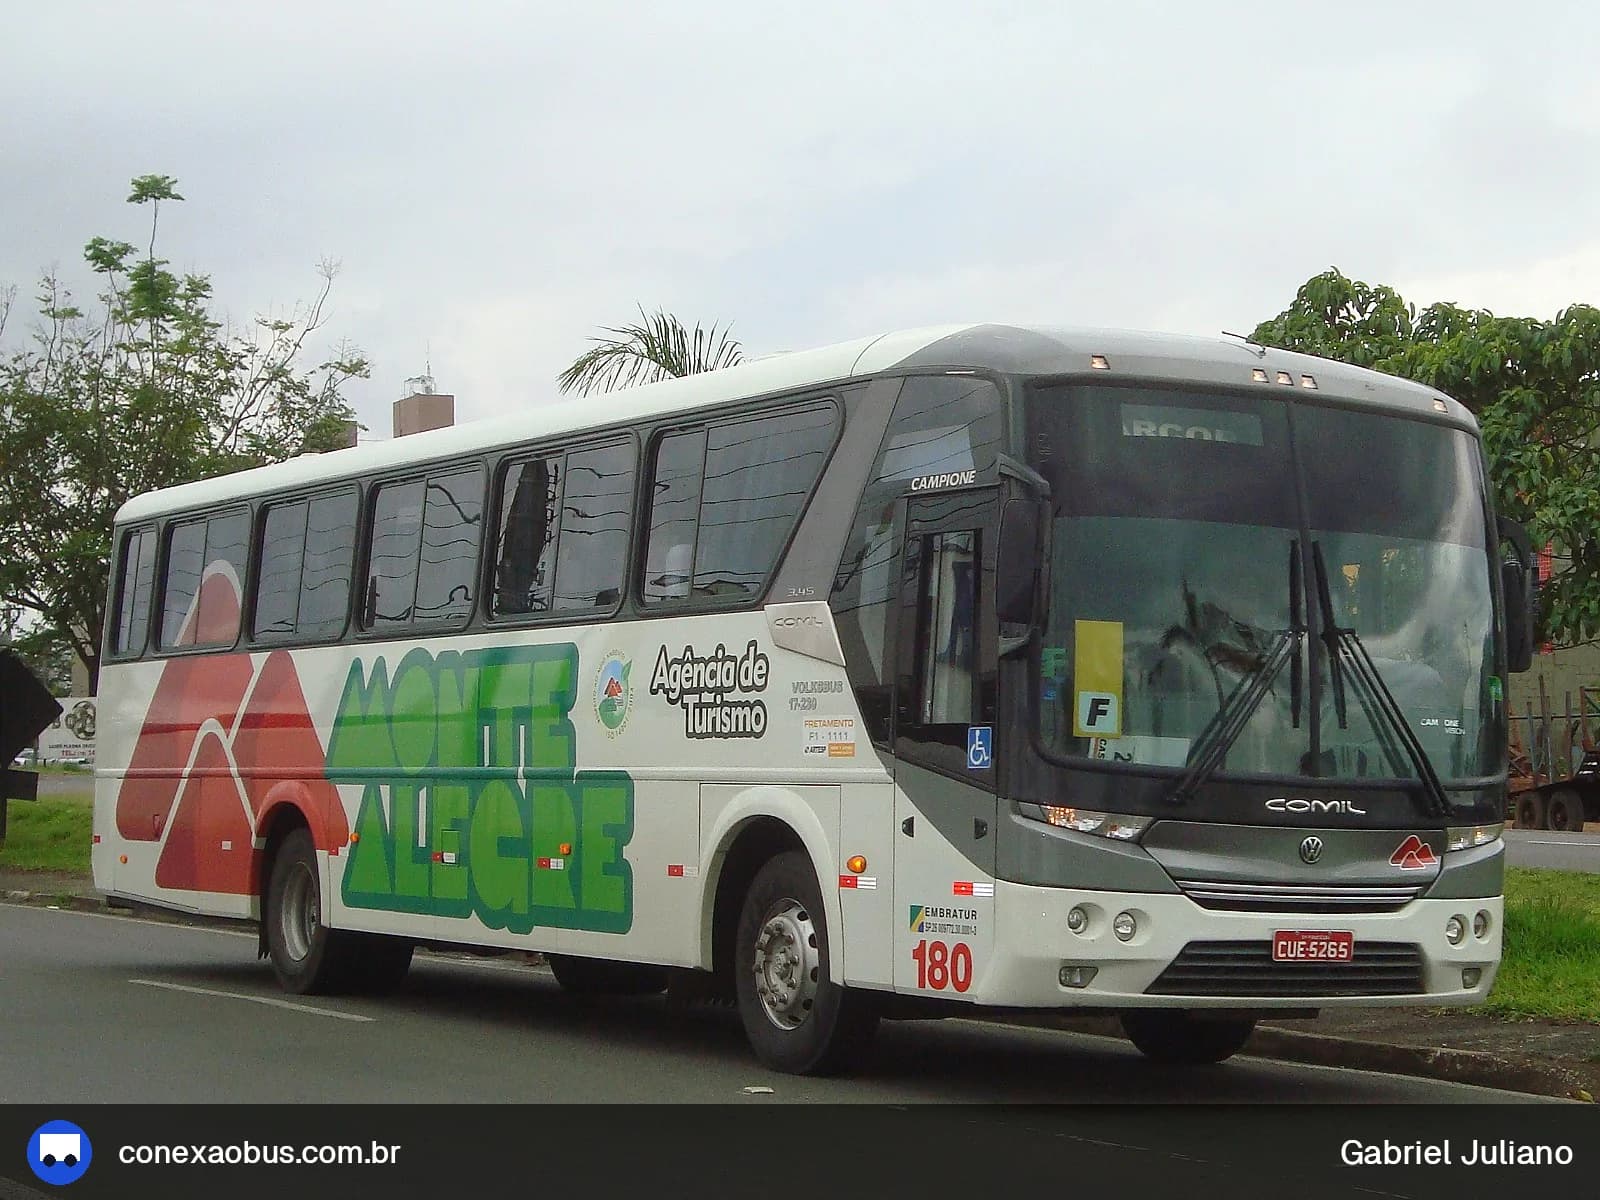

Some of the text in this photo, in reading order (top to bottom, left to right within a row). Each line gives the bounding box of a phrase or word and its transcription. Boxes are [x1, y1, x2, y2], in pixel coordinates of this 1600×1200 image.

[911, 470, 977, 490] CAMPIONE
[774, 616, 824, 628] COMIL
[651, 644, 737, 703] Agência
[738, 640, 769, 692] de
[792, 680, 844, 694] VOLKSBUS
[325, 642, 580, 780] MONTE
[683, 693, 768, 739] Turismo
[1086, 698, 1111, 727] F
[804, 719, 855, 729] FRETAMENTO
[828, 731, 849, 741] 1111
[1265, 798, 1367, 815] COMIL
[341, 770, 634, 935] ALEGRE
[925, 906, 978, 921] EMBRATUR
[912, 939, 973, 993] 180
